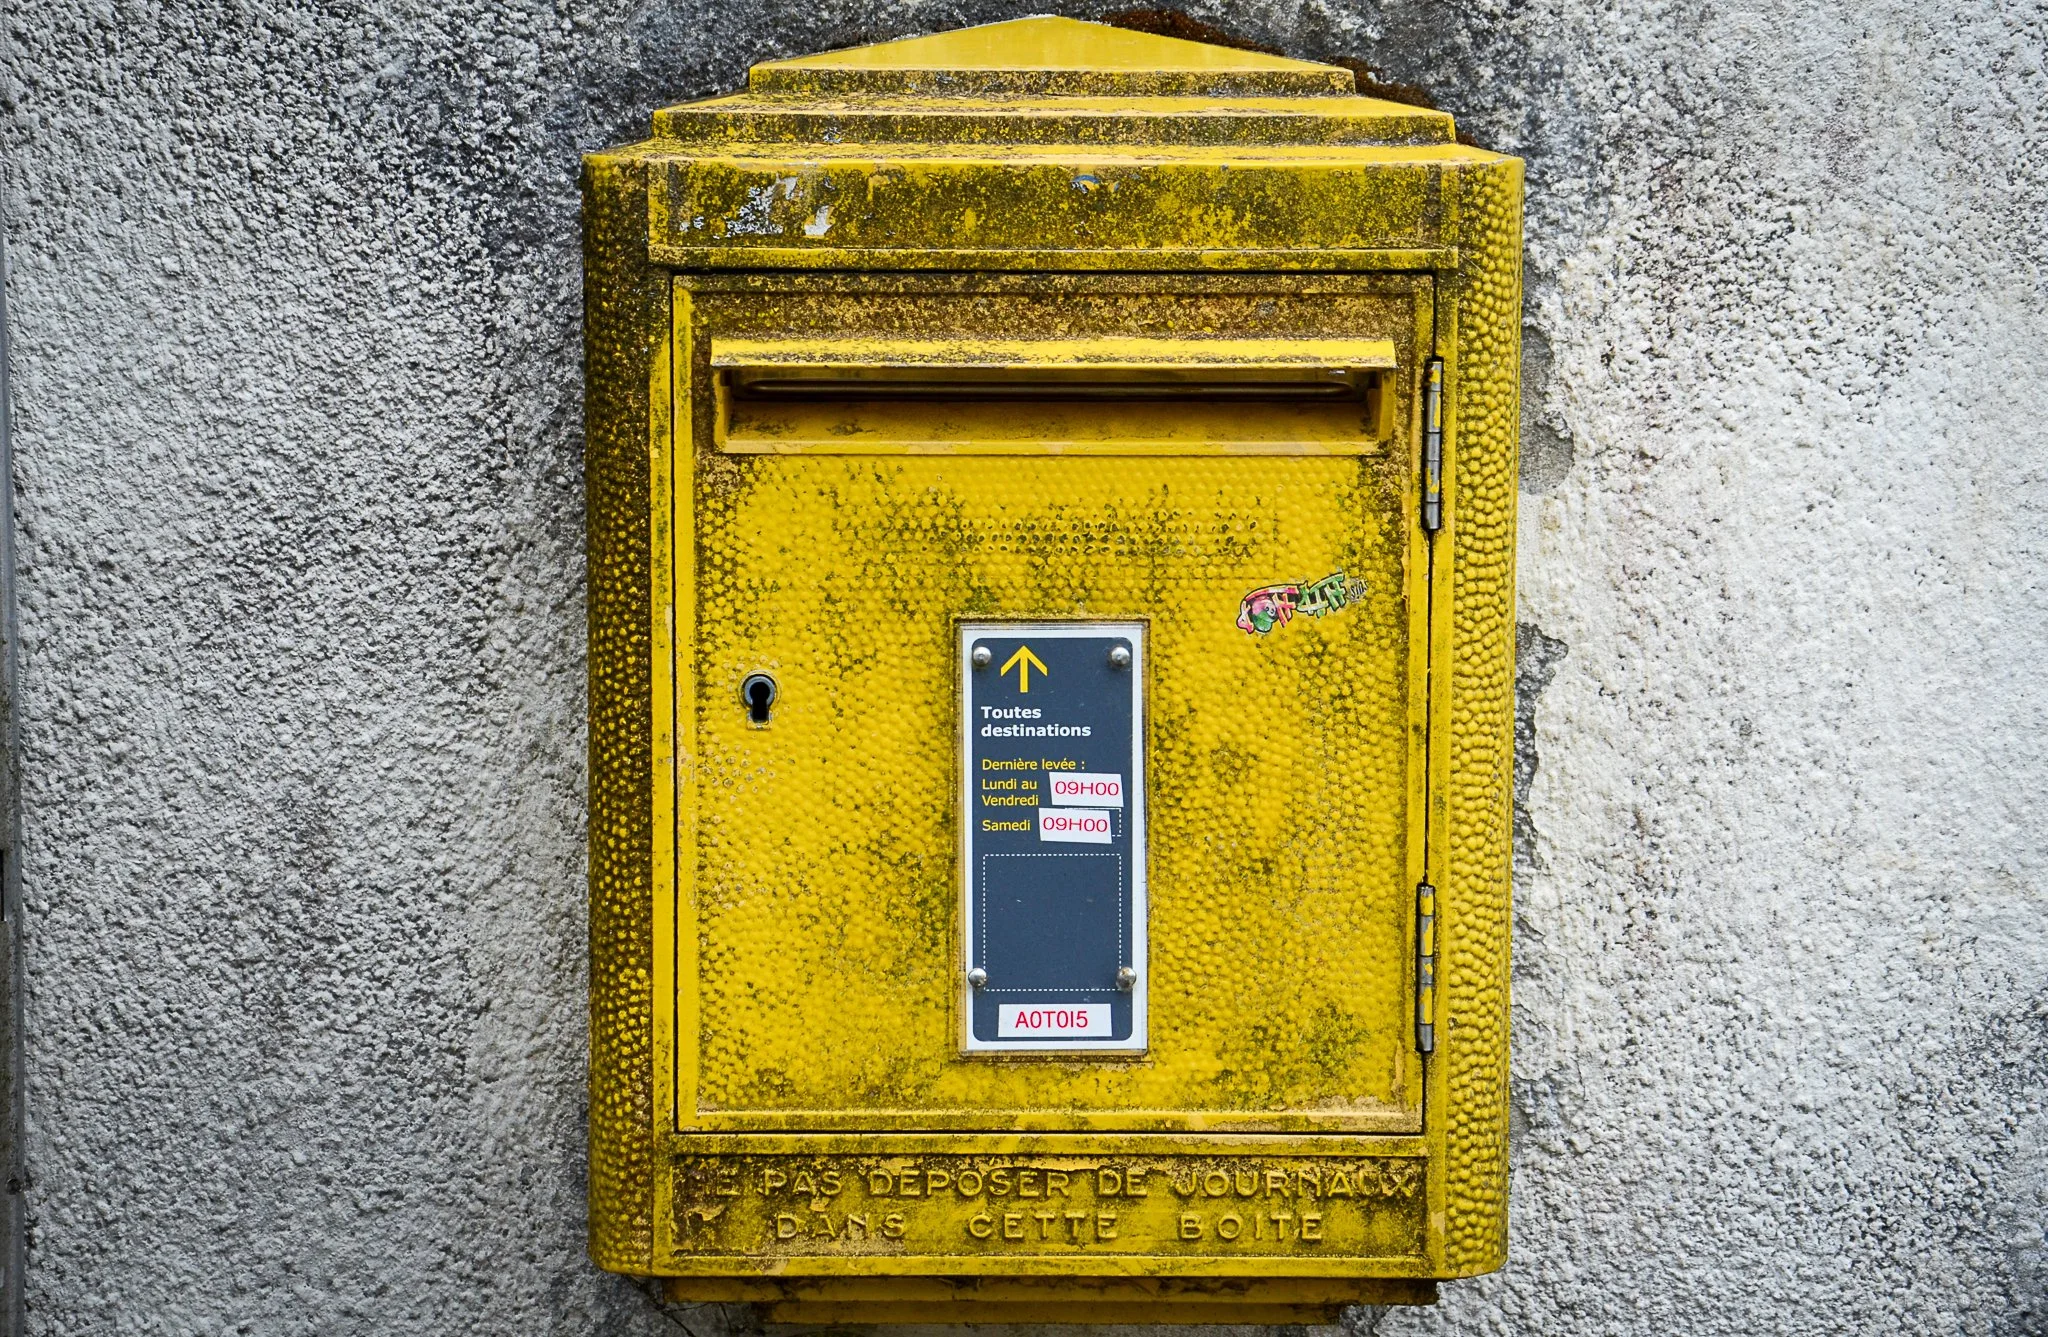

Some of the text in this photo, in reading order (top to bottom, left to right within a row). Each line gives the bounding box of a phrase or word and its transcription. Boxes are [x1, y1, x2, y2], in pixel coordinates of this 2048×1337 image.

[980, 706, 1042, 719] Toutes
[980, 723, 1092, 737] destinations
[981, 757, 1038, 770] Dernière
[1041, 757, 1076, 770] levée
[981, 778, 1037, 790] Lundi au
[1054, 780, 1120, 796] 09H00
[981, 795, 1039, 806] Vendredi
[981, 819, 1031, 831] Samedi
[1042, 816, 1108, 833] 09H00
[763, 1169, 842, 1197] PAS
[868, 1169, 1070, 1197] DEPOSER
[1097, 1169, 1148, 1197] DE
[776, 1212, 1323, 1241] DANS CETTE BOITE
